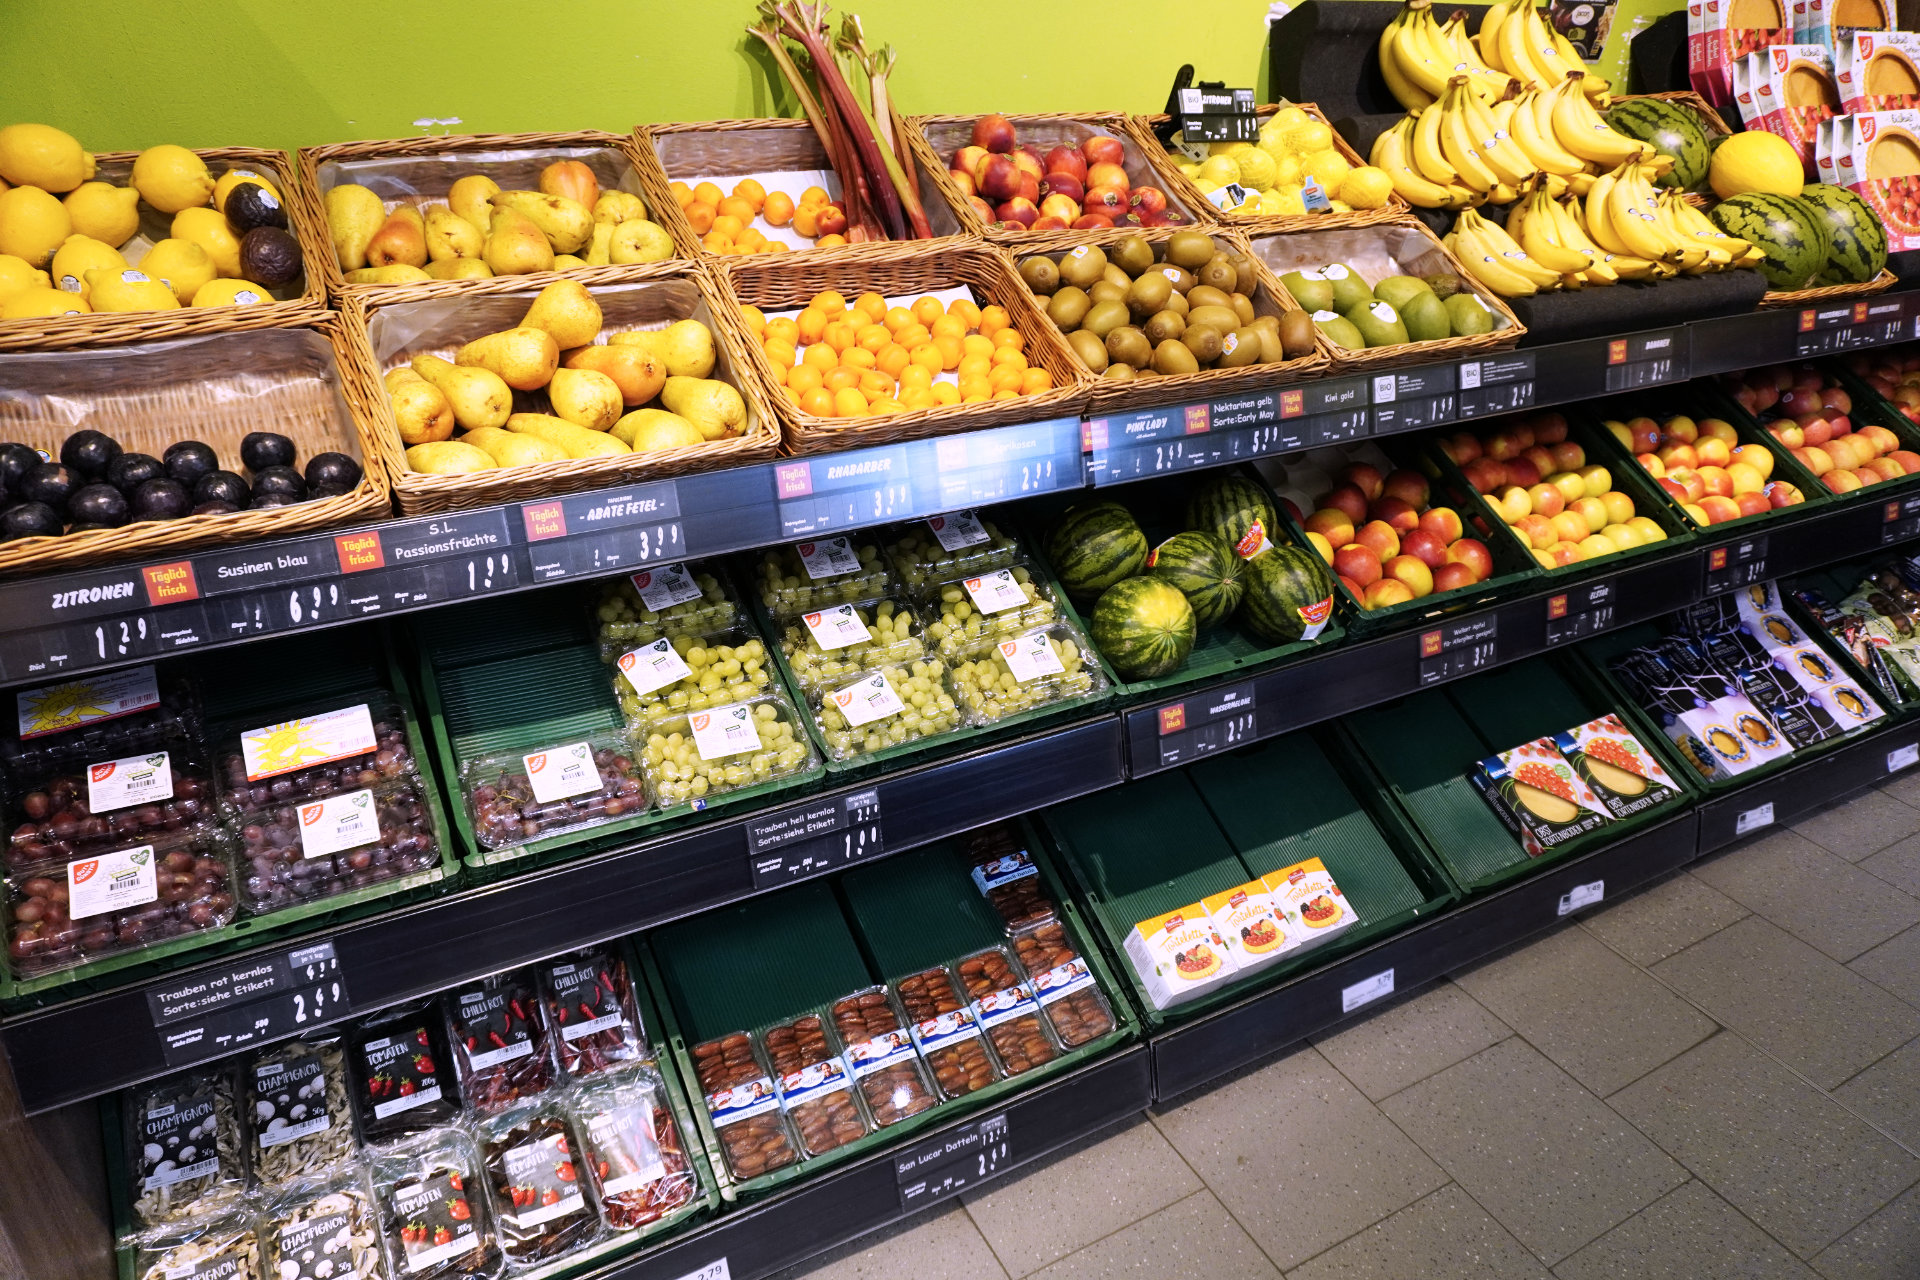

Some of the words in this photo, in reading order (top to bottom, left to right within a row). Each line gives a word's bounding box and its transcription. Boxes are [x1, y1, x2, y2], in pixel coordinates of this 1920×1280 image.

[1202, 95, 1232, 105] ZITRONEN
[1466, 369, 1478, 378] BIO
[1379, 384, 1392, 392] BIO
[1213, 400, 1255, 413] Nektarinen
[1257, 397, 1273, 408] gelb
[1325, 394, 1337, 403] Kiwi
[1340, 391, 1354, 402] gold
[1259, 411, 1275, 420] May
[1125, 421, 1145, 434] PINK
[1145, 417, 1168, 430] LADY
[781, 468, 807, 481] Täglich
[827, 458, 892, 480] RHABARBER
[785, 480, 806, 492] frisch
[529, 508, 560, 522] Täglich
[587, 504, 624, 521] ABATE
[625, 498, 658, 516] FETEL
[429, 522, 458, 536] S.L.
[535, 522, 559, 535] frisch
[341, 536, 376, 553] Täglich
[395, 534, 498, 560] Passionsfrüchte
[217, 562, 274, 579] Susinen
[277, 554, 309, 570] blau
[349, 551, 376, 566] frisch
[149, 567, 188, 584] Täglich
[51, 582, 135, 609] ZITRONEN
[157, 583, 188, 598] frisch
[95, 617, 147, 660] 1.29
[1209, 696, 1252, 715] WASSERMELONE
[1607, 796, 1624, 811] OBST
[1614, 796, 1654, 818] TORTENBODEN
[754, 821, 788, 836] Trauben
[790, 814, 805, 825] hell
[807, 806, 835, 821] kernlos
[807, 818, 835, 833] Etikett
[1534, 824, 1553, 839] OBST
[1541, 823, 1584, 847] TORTENBODEN
[291, 943, 329, 958] Grundpreis
[157, 984, 207, 1003] Trauben
[210, 977, 229, 989] rot
[232, 964, 273, 982] kernlos
[554, 973, 579, 990] CHILLI
[578, 966, 594, 982] ROT
[234, 977, 275, 996] Etikett
[293, 982, 340, 1024] 2.49
[462, 1000, 487, 1019] CHILLI
[487, 994, 504, 1012] ROT
[604, 1002, 618, 1013] 50g
[254, 1018, 270, 1030] 500
[514, 1031, 528, 1041] 50g
[366, 1042, 409, 1066] TOMATEN
[257, 1062, 321, 1093] CHAMPIGNON
[421, 1077, 436, 1088] 200g
[146, 1101, 214, 1136] CHAMPIGNON
[312, 1106, 325, 1116] 50g
[617, 1114, 633, 1132] ROT
[201, 1148, 216, 1158] 50g
[899, 1160, 916, 1174] San
[918, 1149, 943, 1165] Lucar
[945, 1133, 979, 1153] Datteln
[506, 1149, 550, 1175] TOMATEN
[562, 1184, 579, 1196] 200g
[398, 1187, 443, 1216] TOMATEN
[281, 1215, 347, 1252] CHAMPIGNON
[456, 1223, 474, 1236] 200g
[338, 1262, 352, 1273] 50g
